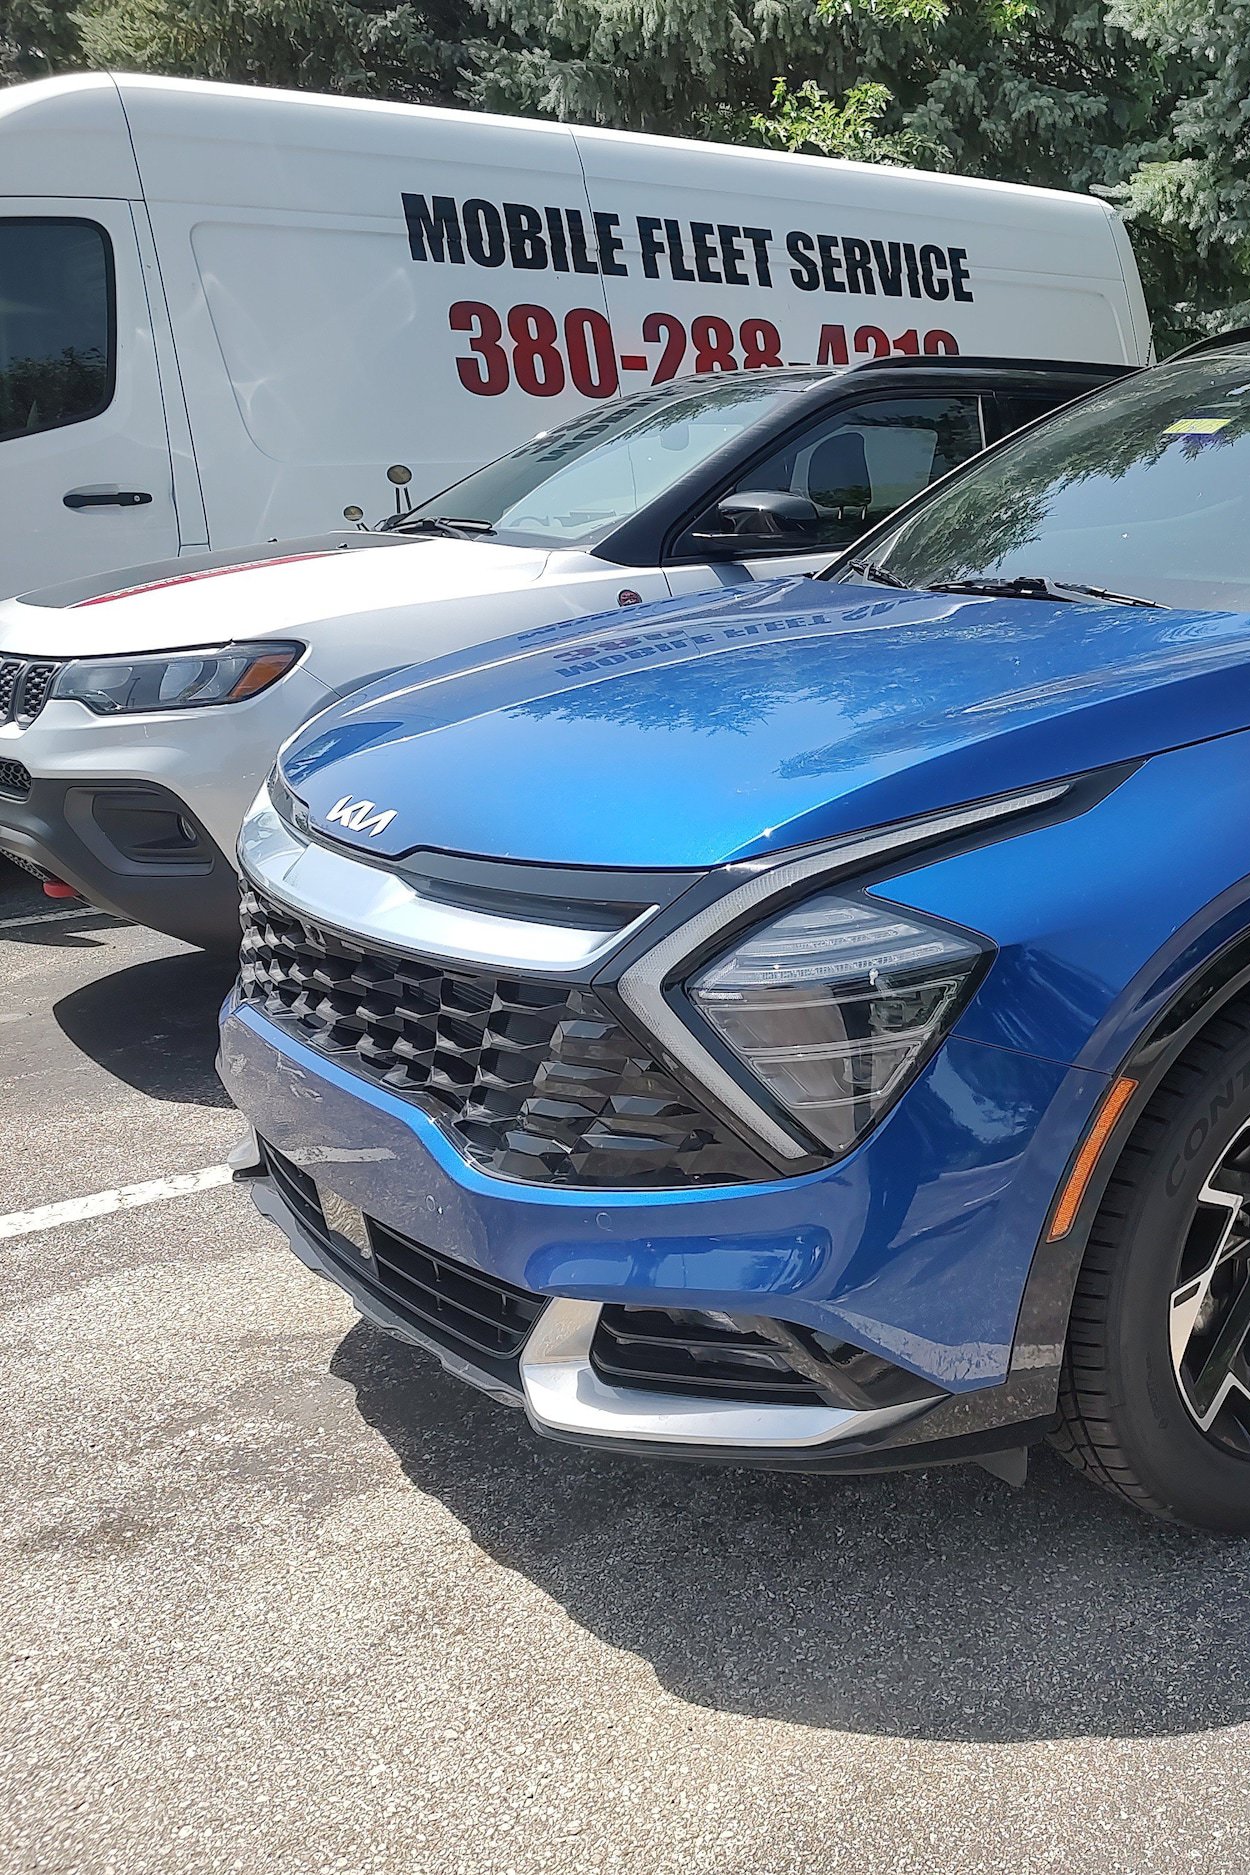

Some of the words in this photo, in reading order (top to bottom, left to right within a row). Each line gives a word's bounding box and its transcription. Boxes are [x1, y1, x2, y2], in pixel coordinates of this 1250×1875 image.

[401, 193, 629, 277] MOBILE
[635, 216, 773, 288] FLEET
[786, 231, 974, 302] SERVICE
[449, 301, 959, 398] 380-2884
[325, 794, 398, 837] KIA
